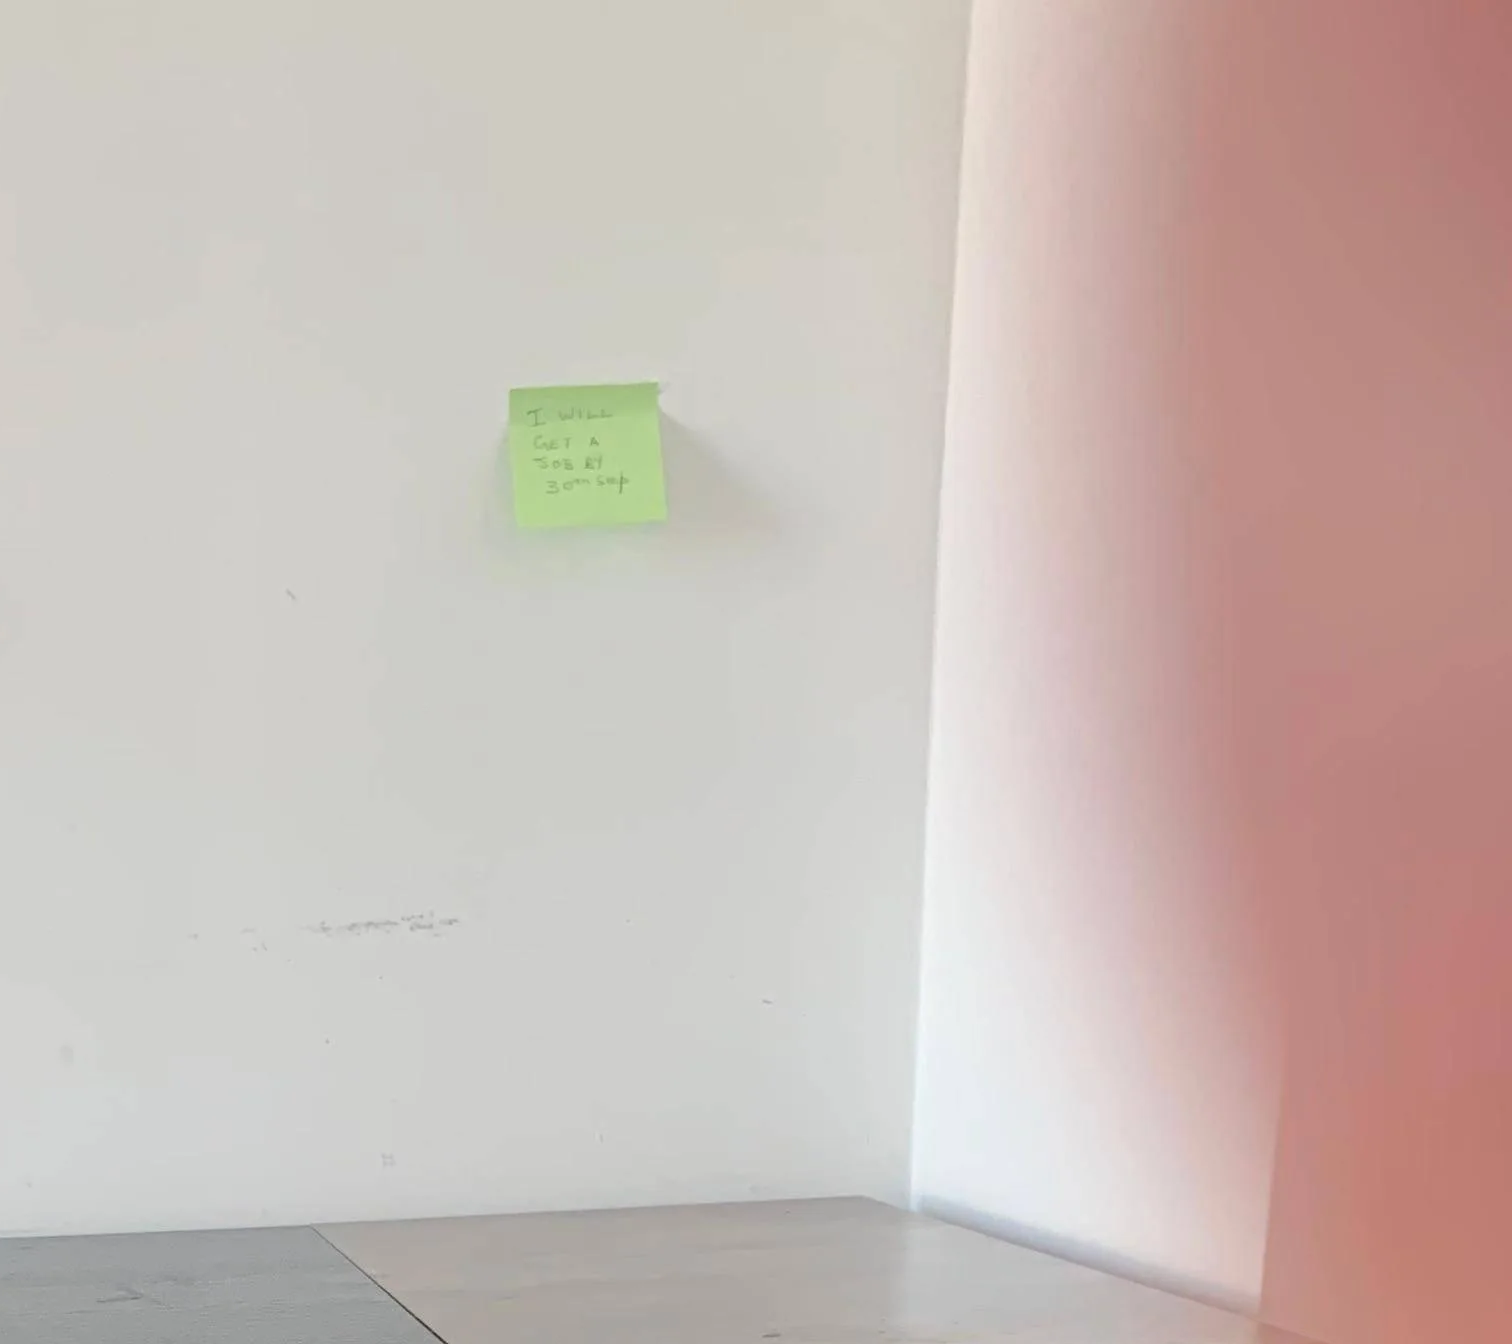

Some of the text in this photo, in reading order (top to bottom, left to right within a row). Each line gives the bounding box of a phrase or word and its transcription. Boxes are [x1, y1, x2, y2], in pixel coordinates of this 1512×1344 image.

[526, 407, 615, 427] I WILL
[533, 434, 600, 452] GET A
